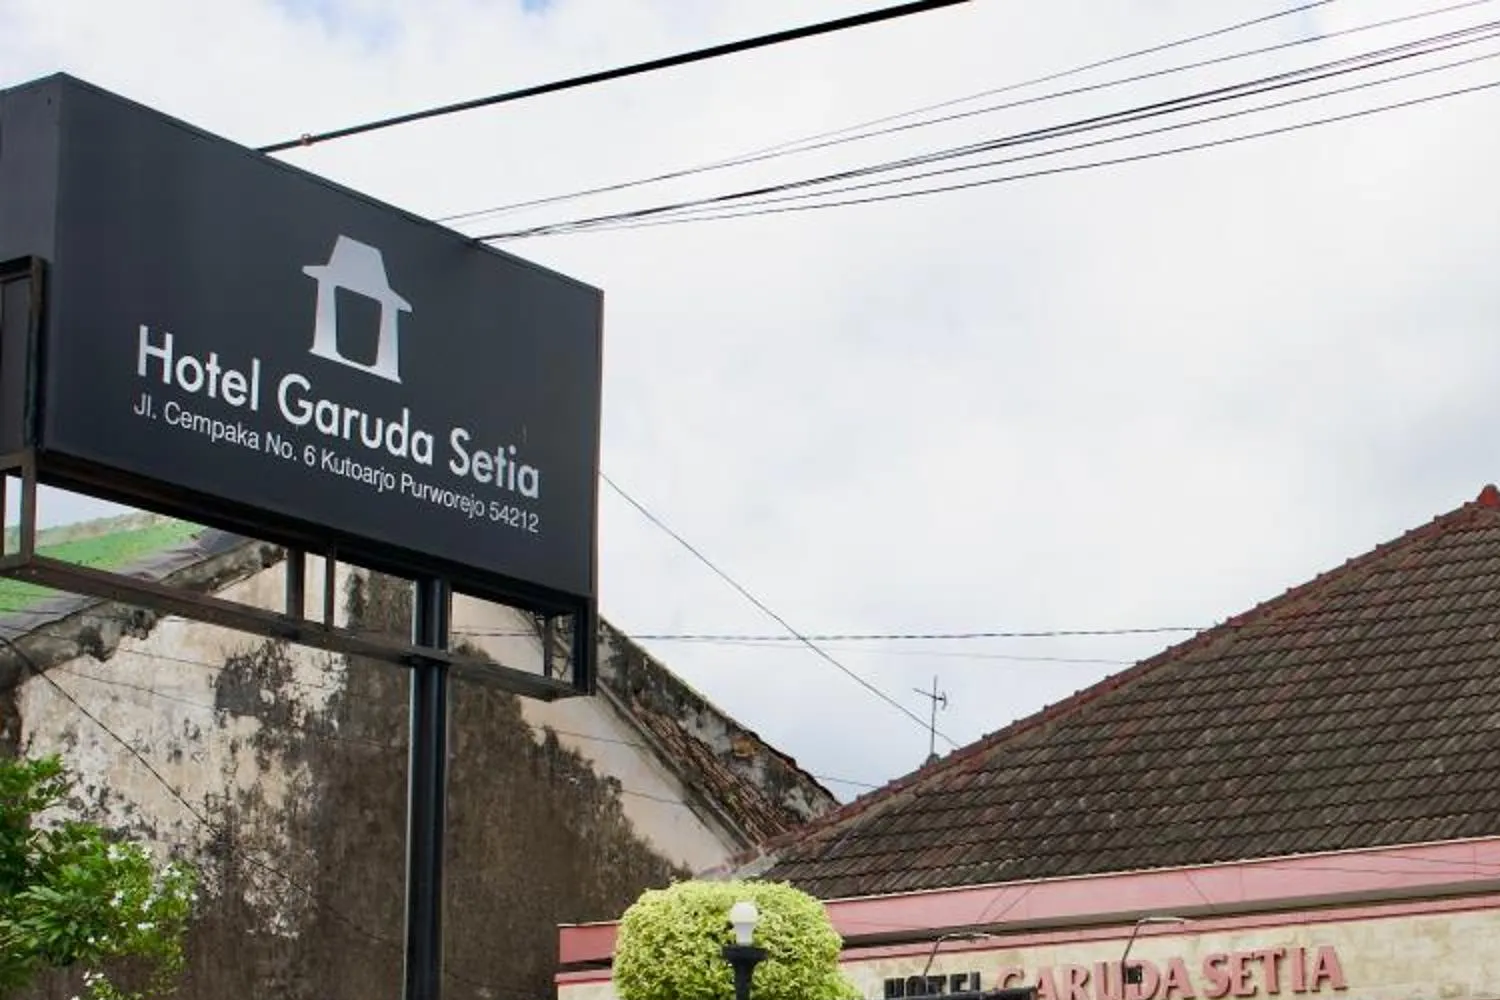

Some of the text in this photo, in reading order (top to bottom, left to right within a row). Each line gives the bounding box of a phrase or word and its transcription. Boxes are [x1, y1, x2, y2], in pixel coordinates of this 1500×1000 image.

[133, 393, 540, 534] Jl. Cempaka No. 6 Kutoarjo Purworejo 54212
[137, 324, 540, 499] Hotel Garuda Setia
[1202, 945, 1348, 1000] SETIA
